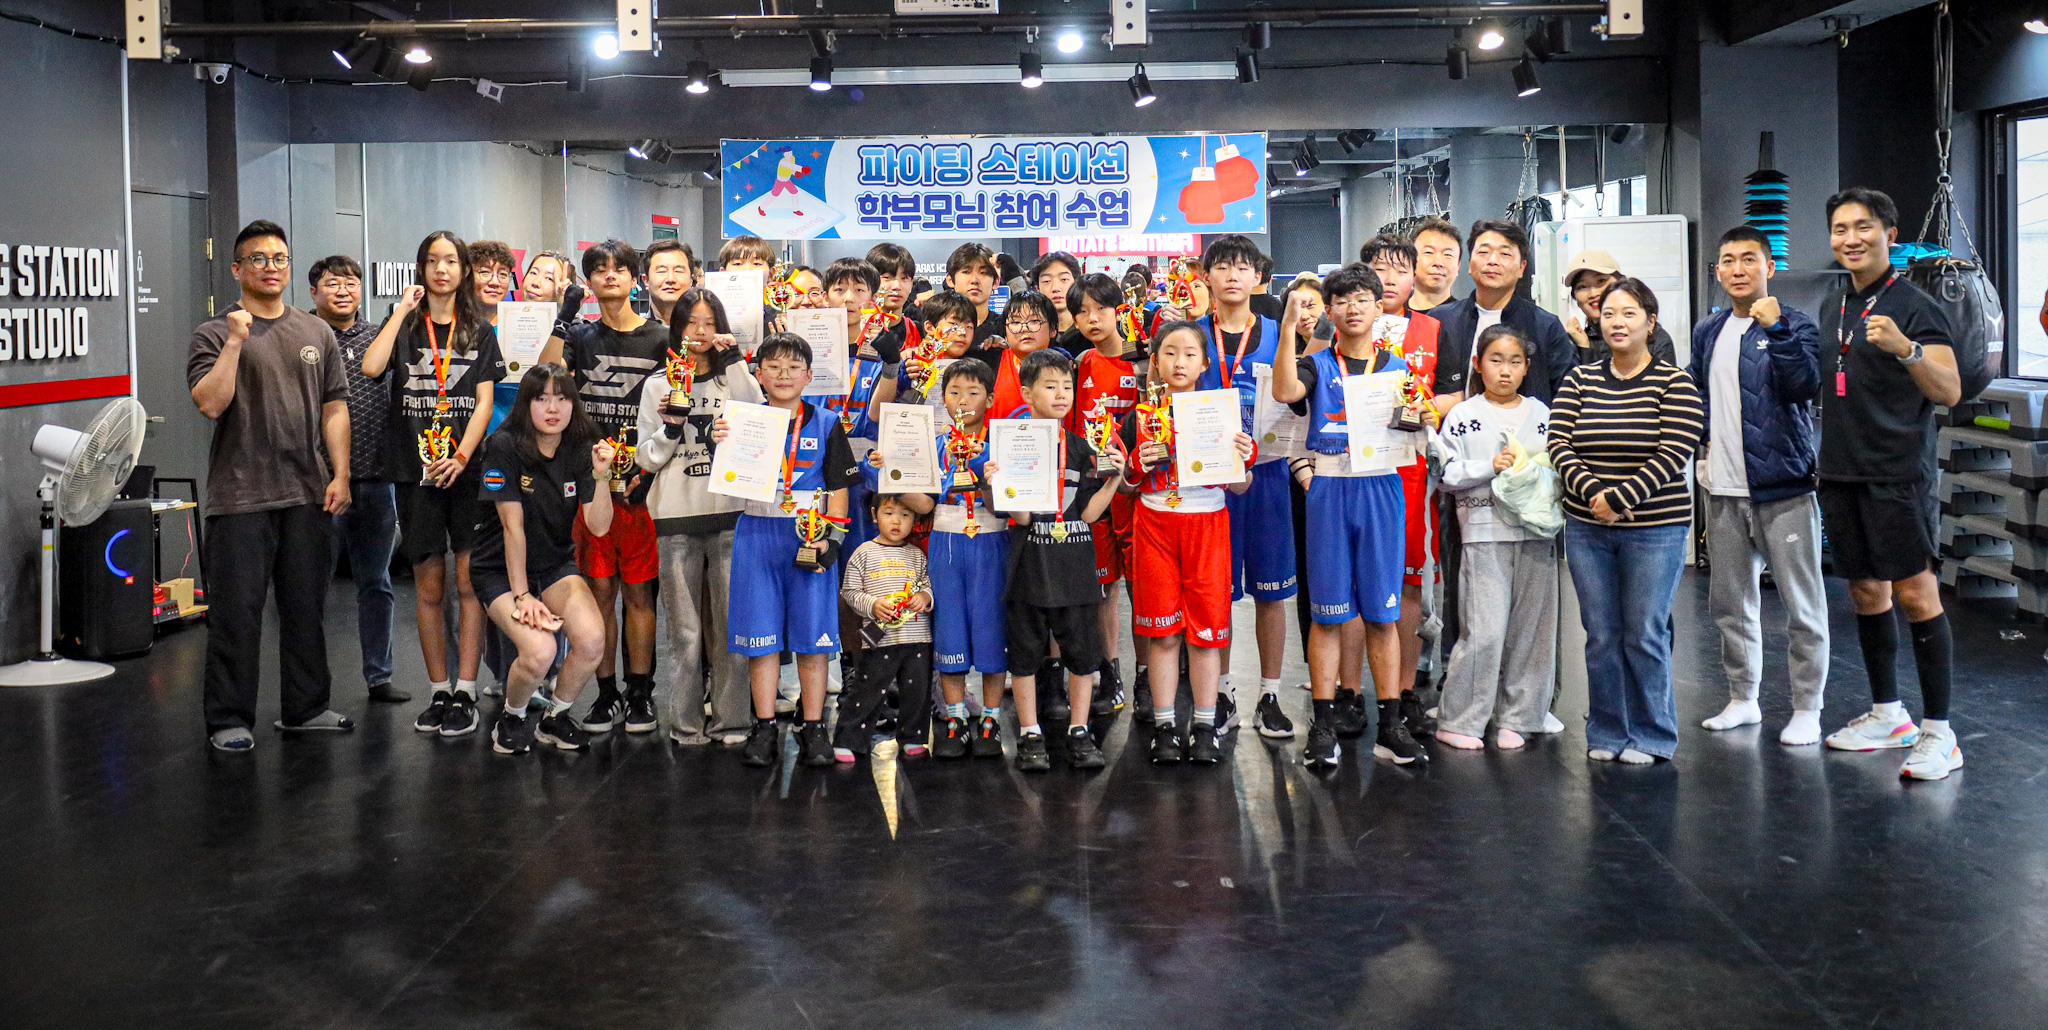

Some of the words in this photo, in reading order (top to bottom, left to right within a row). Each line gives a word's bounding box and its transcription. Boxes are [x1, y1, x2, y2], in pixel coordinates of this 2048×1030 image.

[858, 144, 973, 186] 파이팅
[979, 142, 1129, 185] 스테이션
[787, 216, 825, 236] Boxing
[857, 191, 985, 231] 학부모님
[993, 190, 1058, 231] 참여
[1064, 188, 1130, 229] 수업
[17, 245, 119, 296] STATION
[0, 307, 88, 361] STUDIO
[402, 394, 438, 409] FIGHTIN
